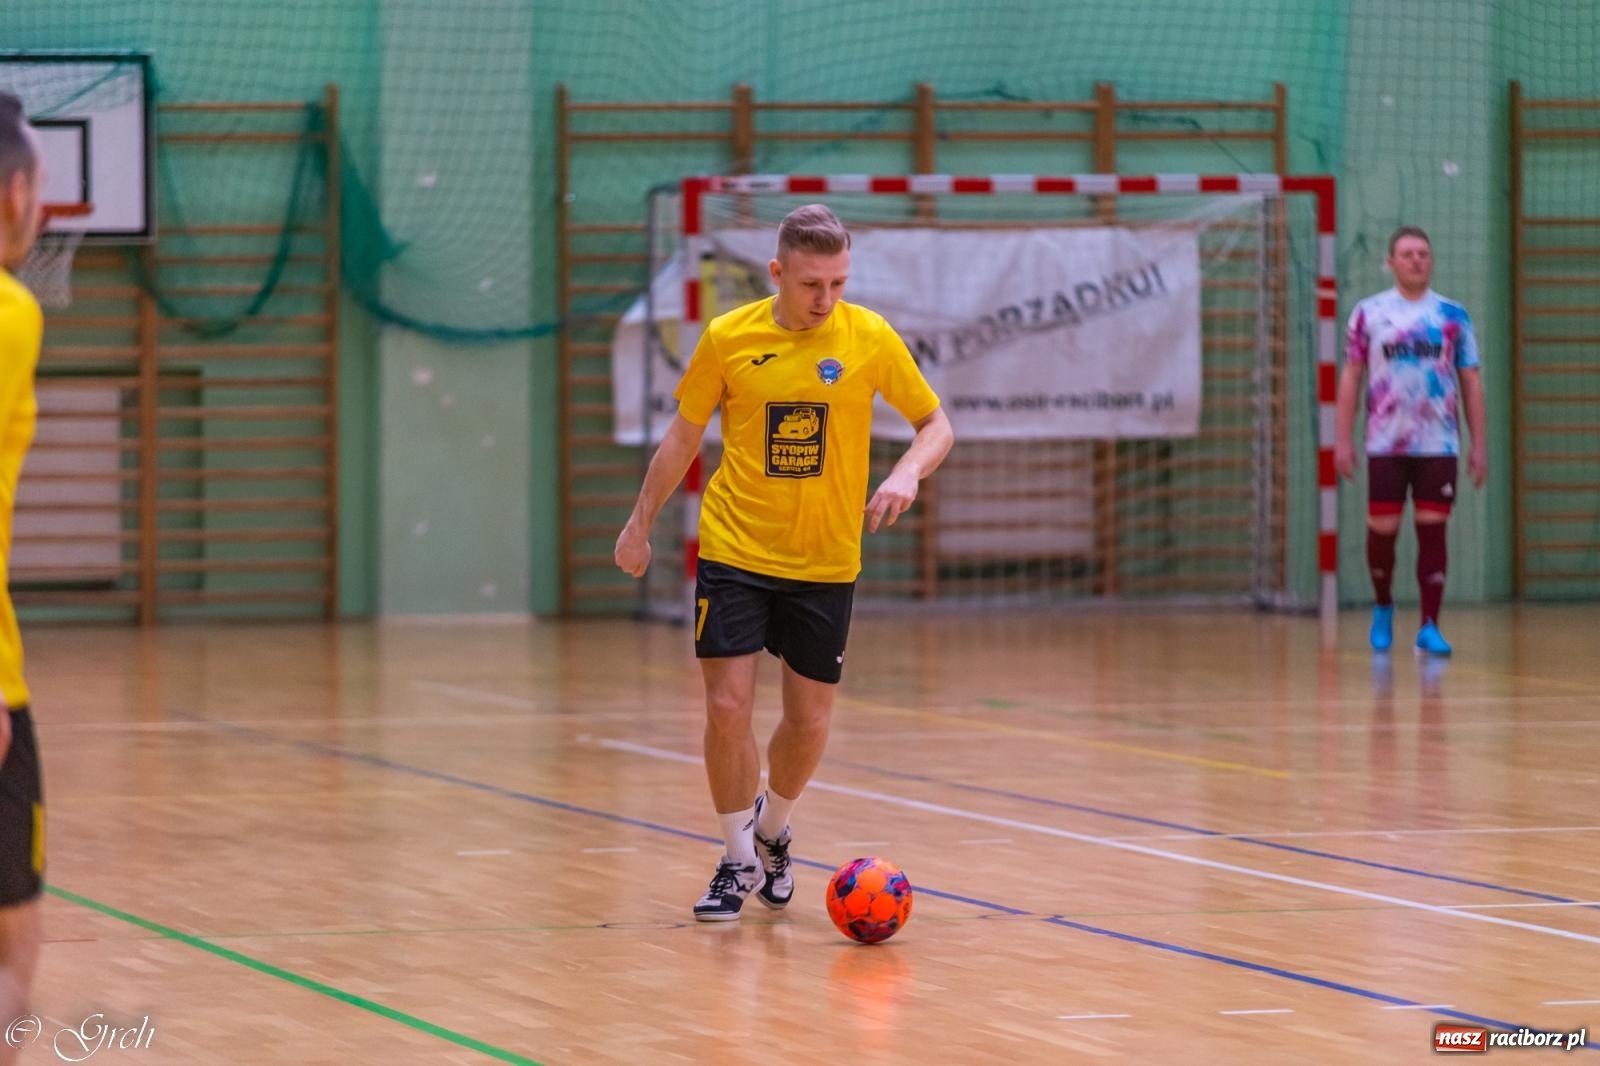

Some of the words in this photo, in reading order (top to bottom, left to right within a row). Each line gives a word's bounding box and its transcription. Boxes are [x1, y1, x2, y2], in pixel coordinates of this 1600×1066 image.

[771, 444, 819, 456] STOPIW
[771, 455, 819, 467] GARAGE
[695, 598, 709, 641] 7
